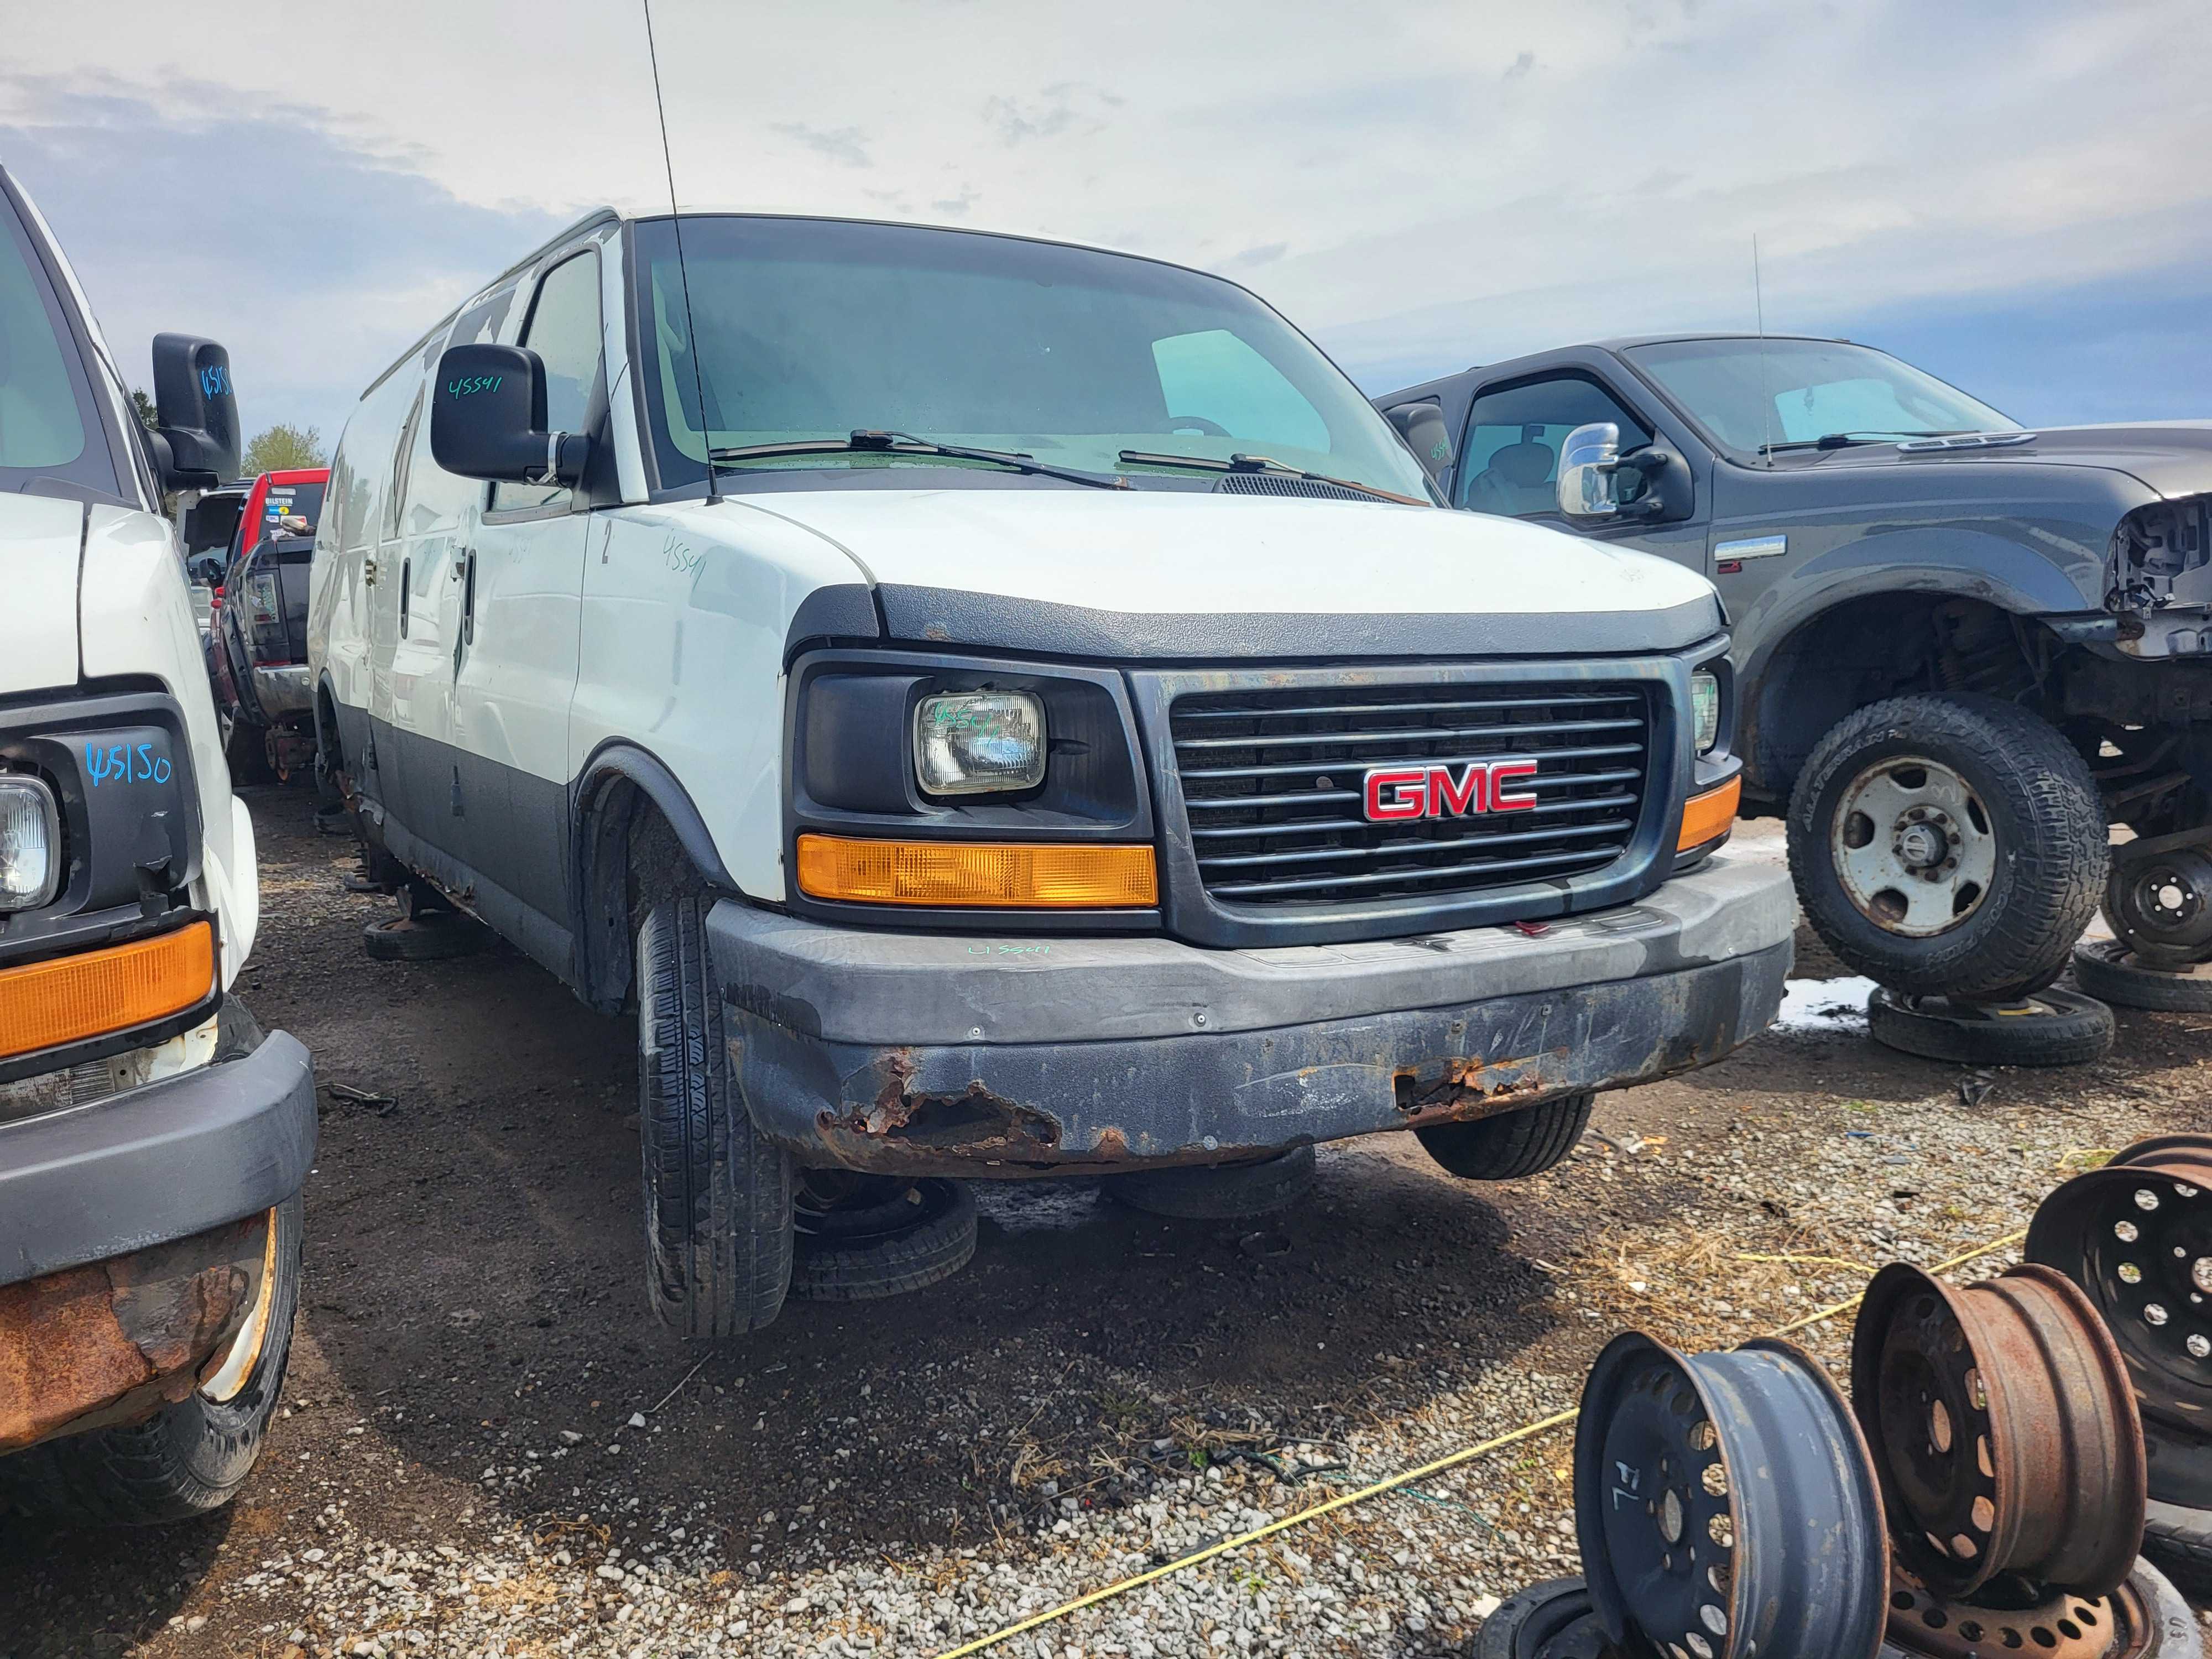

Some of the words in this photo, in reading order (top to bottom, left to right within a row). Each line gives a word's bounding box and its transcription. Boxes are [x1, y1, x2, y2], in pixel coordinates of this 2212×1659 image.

[448, 377, 502, 399] 45541
[86, 743, 172, 787] 45150
[1364, 759, 1537, 822] GMC
